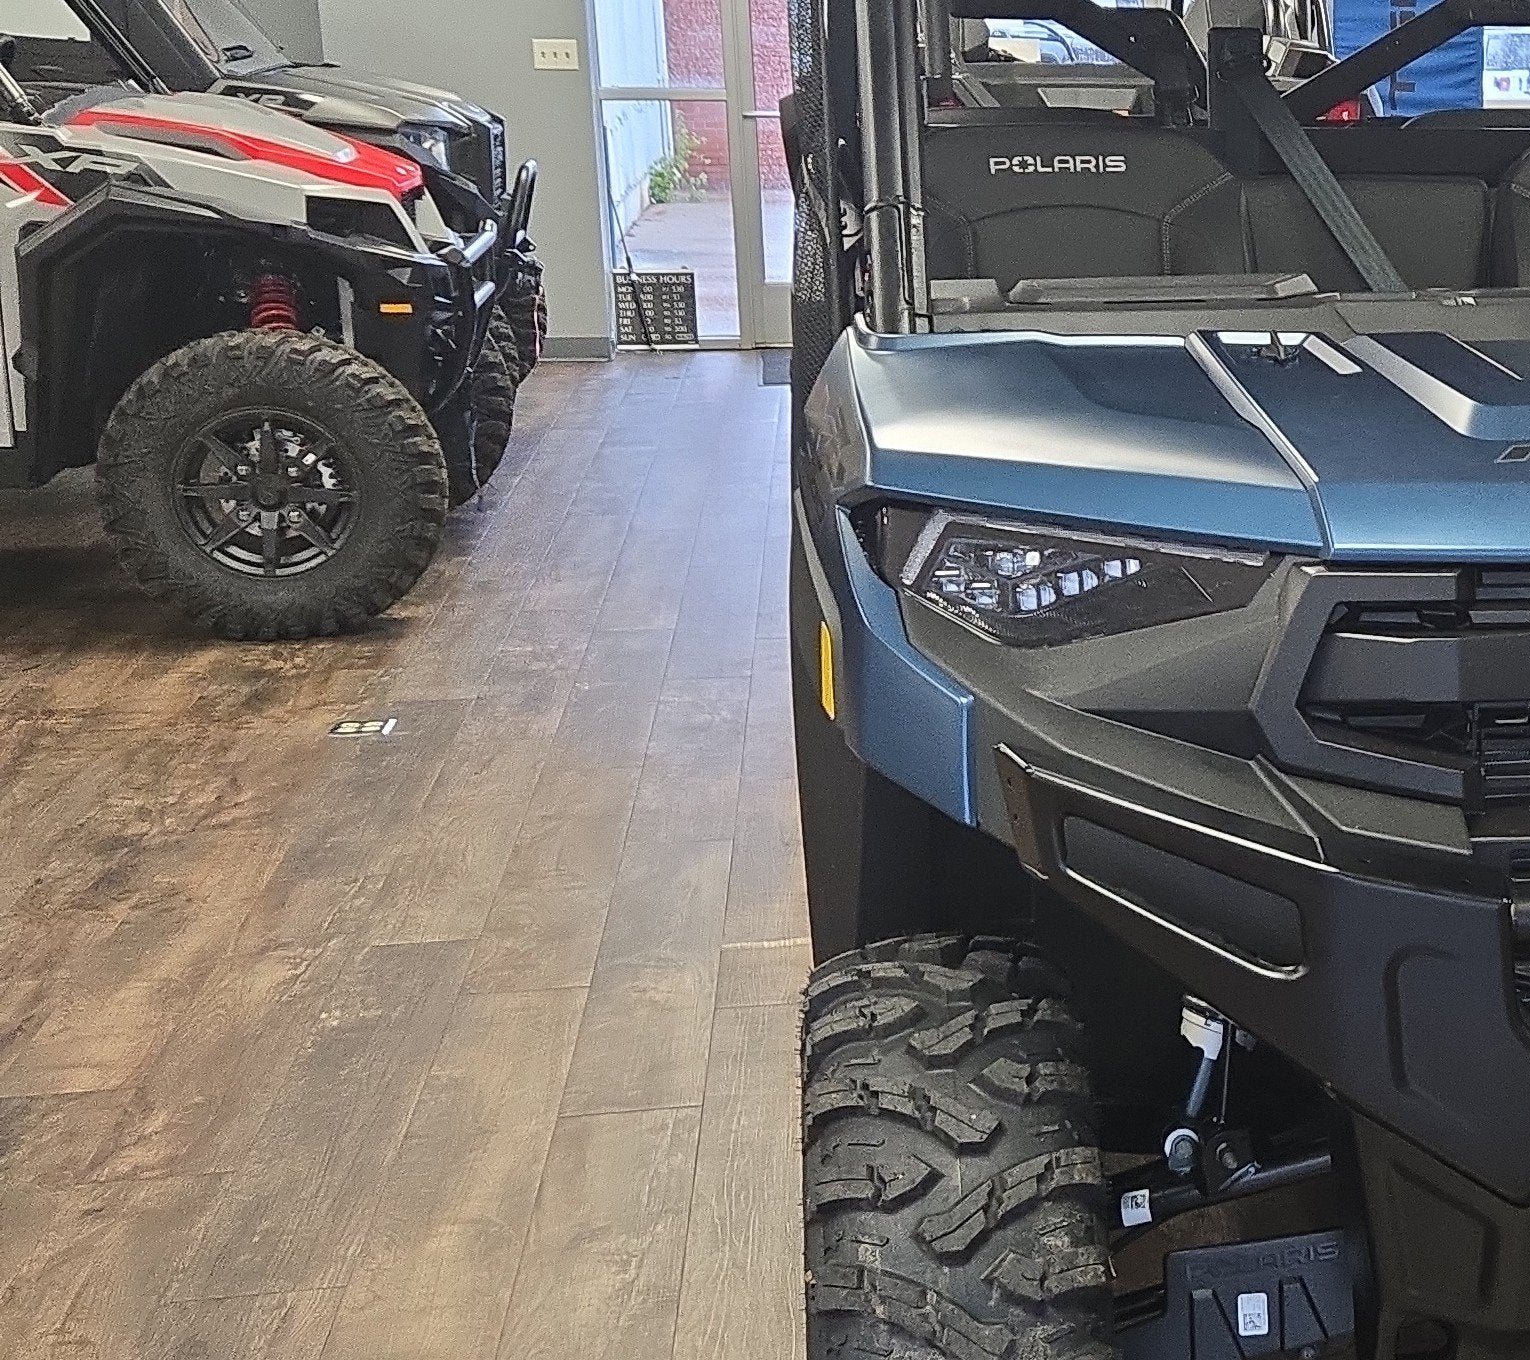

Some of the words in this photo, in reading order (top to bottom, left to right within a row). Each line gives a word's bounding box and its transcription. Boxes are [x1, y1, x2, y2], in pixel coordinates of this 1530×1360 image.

[10, 143, 141, 174] XP
[988, 154, 1127, 175] POLARIS
[659, 275, 692, 284] HOURS
